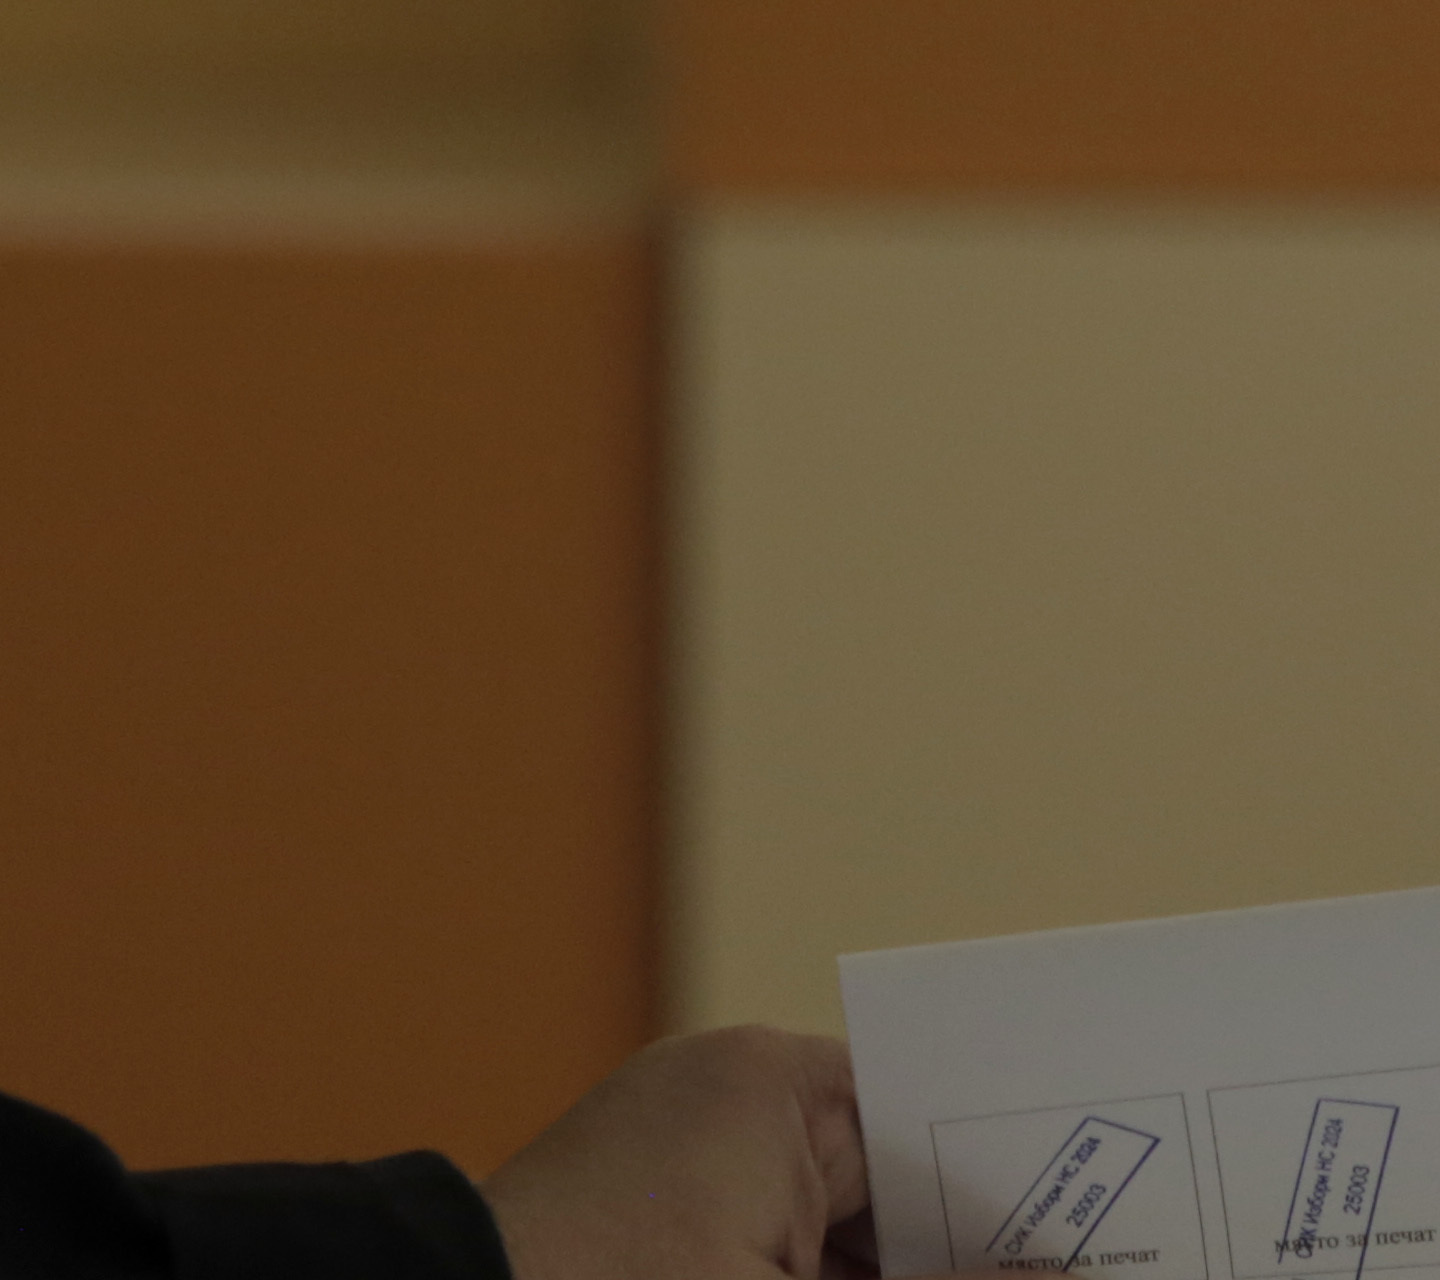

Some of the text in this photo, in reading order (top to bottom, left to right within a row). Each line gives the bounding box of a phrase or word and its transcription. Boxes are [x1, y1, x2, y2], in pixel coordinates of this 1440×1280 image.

[1322, 1118, 1344, 1148] 2024
[1317, 1151, 1335, 1171] НС
[1005, 1136, 1101, 1255] СИК Избори НС 2024
[1066, 1183, 1106, 1228] 25003
[1304, 1175, 1331, 1224] Избори
[1343, 1166, 1370, 1215] 25003
[1376, 1228, 1437, 1245] печат
[1100, 1249, 1160, 1266] печат
